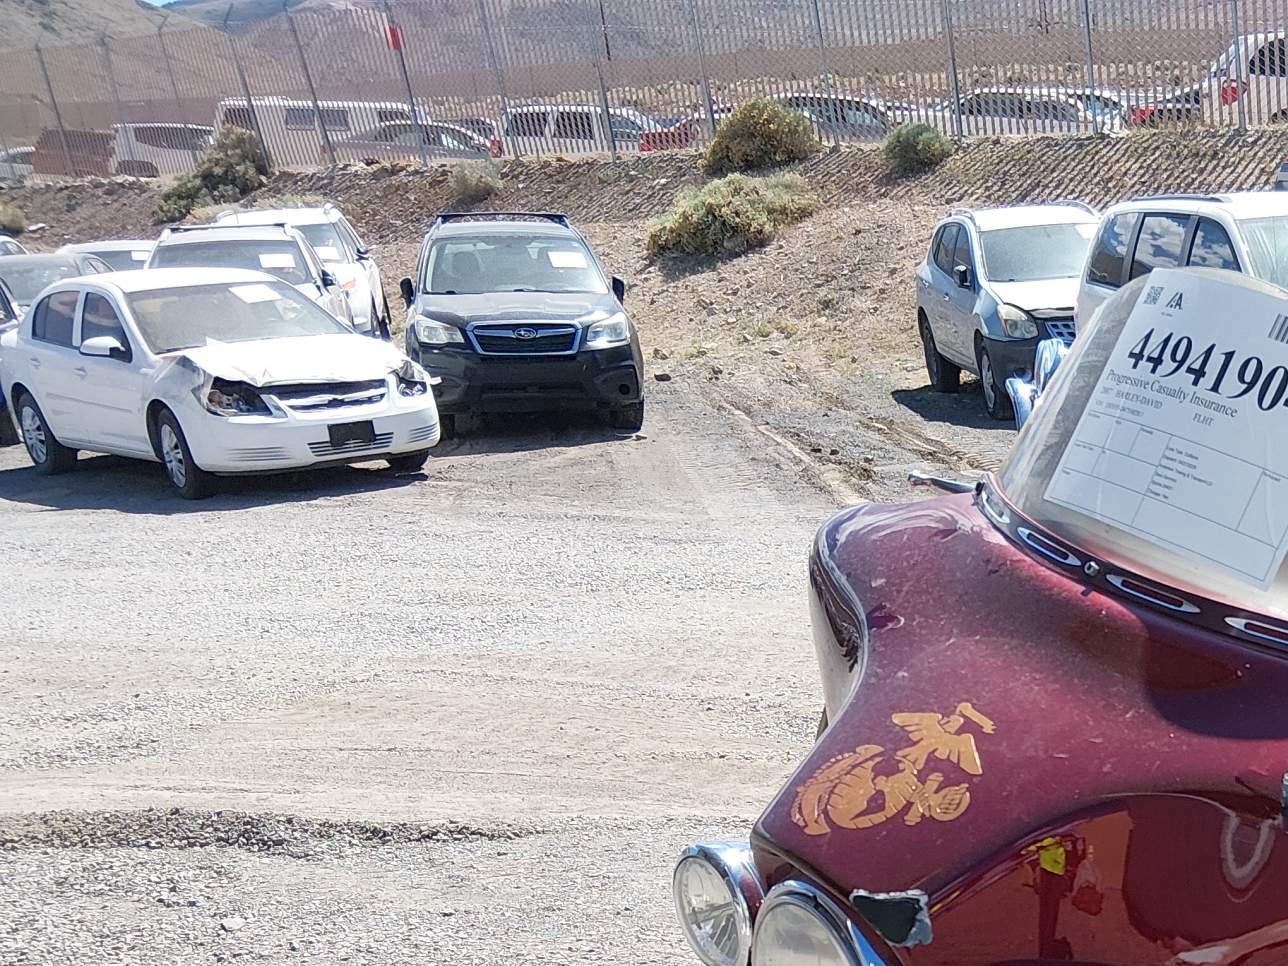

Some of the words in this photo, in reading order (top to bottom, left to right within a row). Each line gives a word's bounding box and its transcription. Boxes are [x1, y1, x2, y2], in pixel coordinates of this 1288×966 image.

[1105, 369, 1150, 393] Progressive
[1150, 380, 1190, 404] Casualty
[1190, 390, 1238, 418] Insurance
